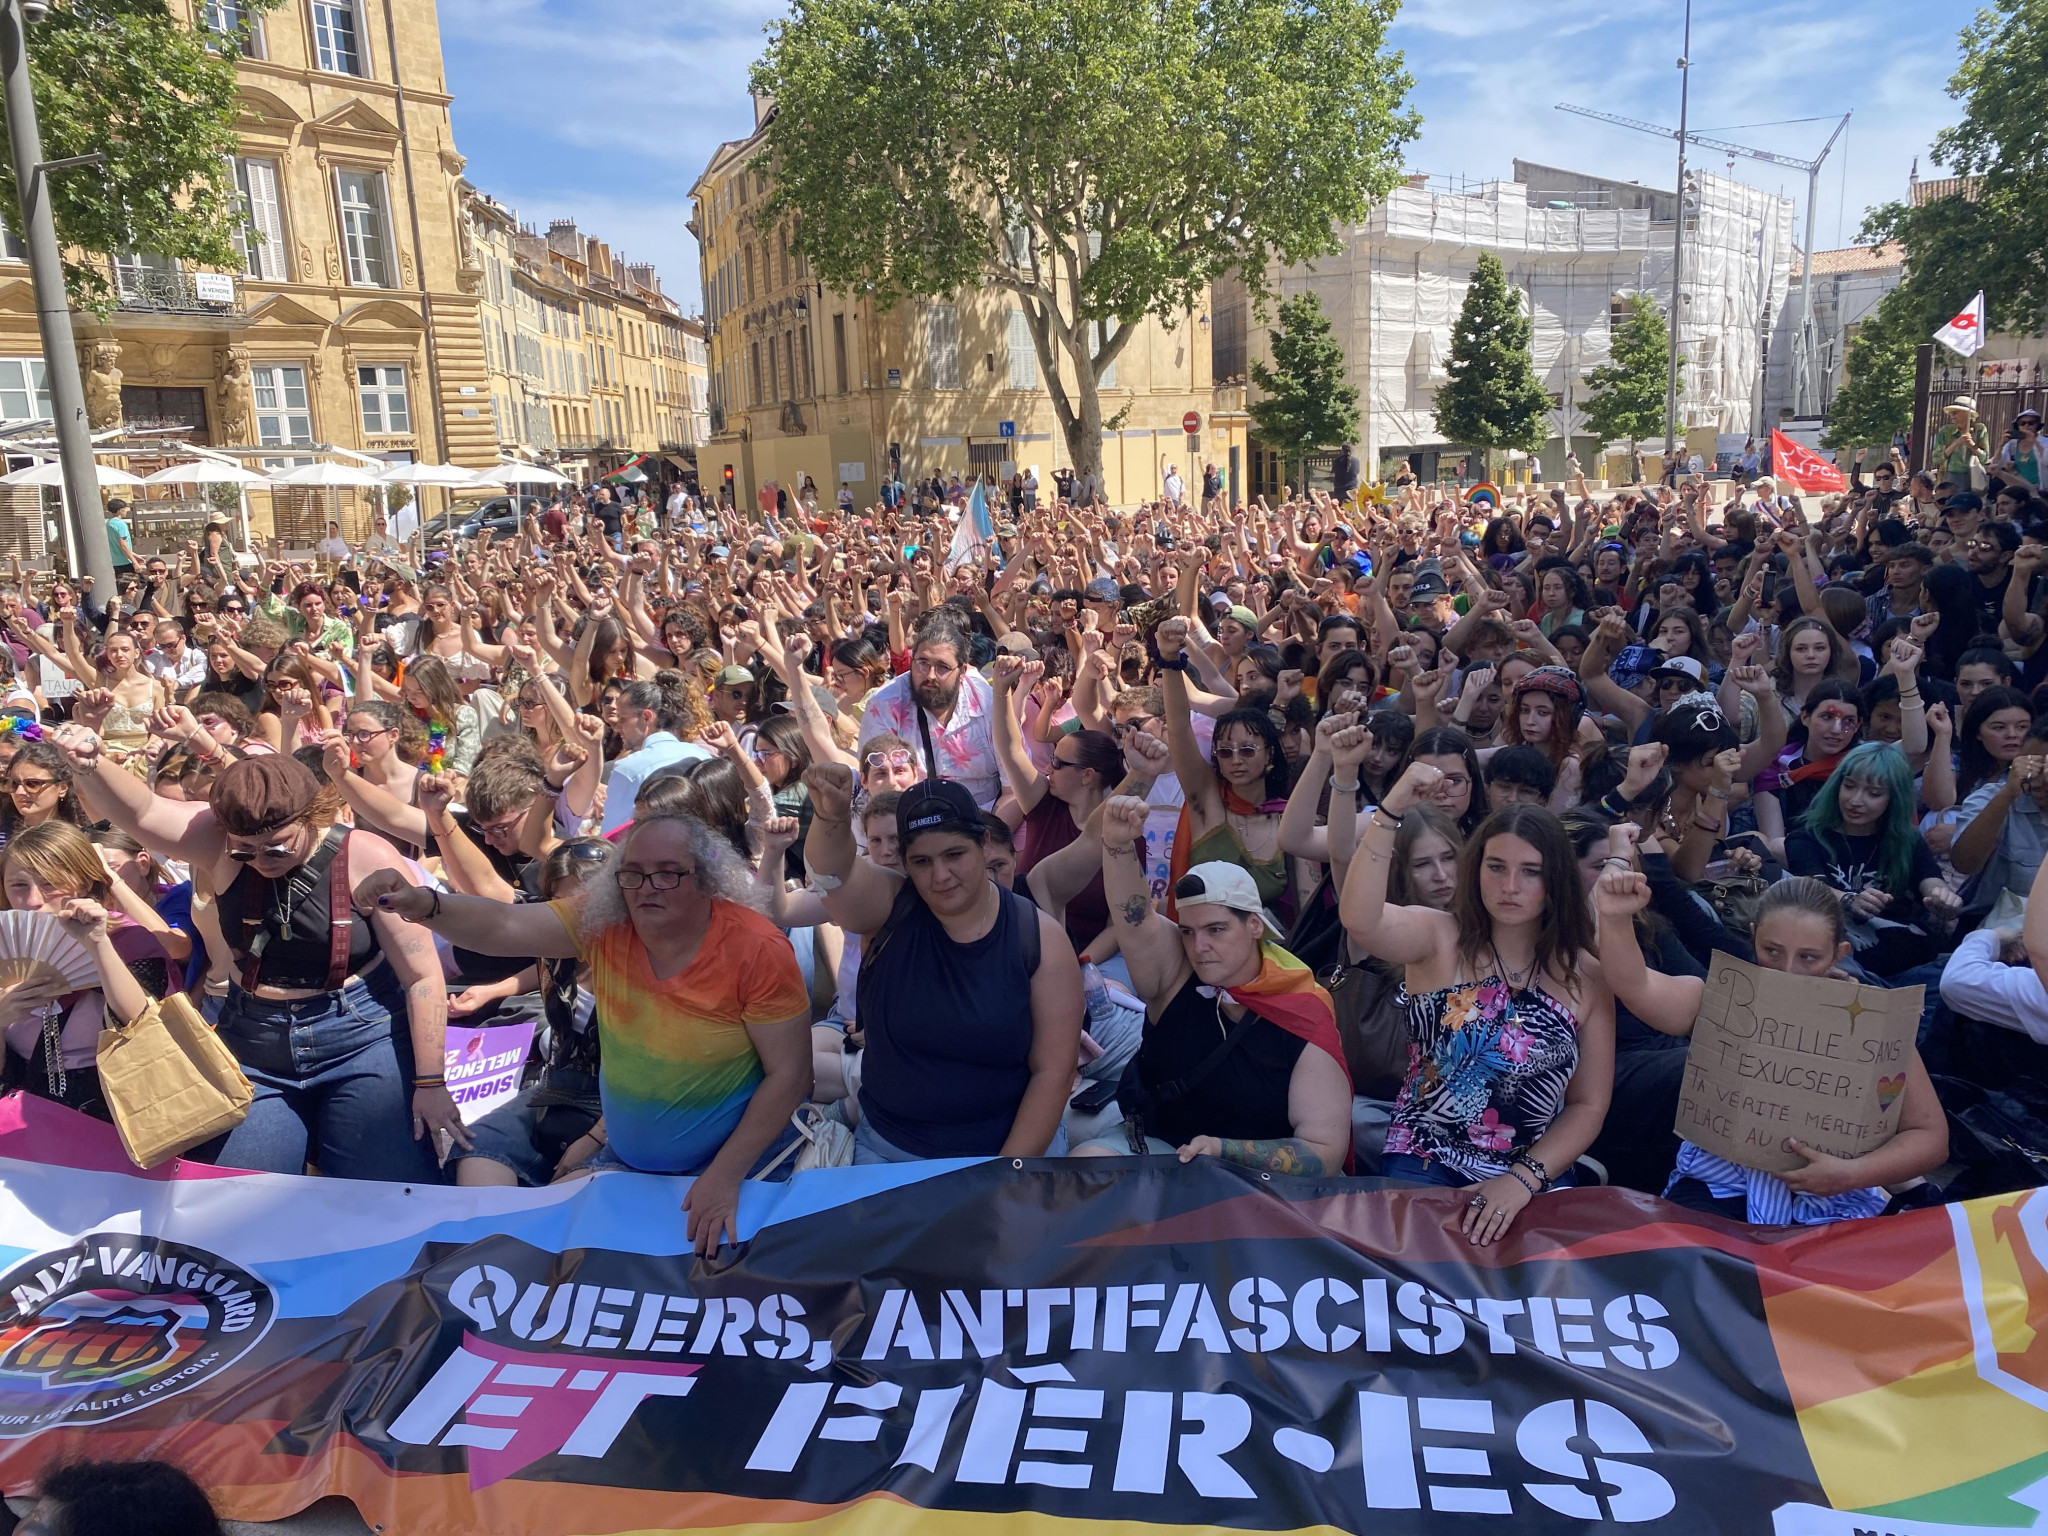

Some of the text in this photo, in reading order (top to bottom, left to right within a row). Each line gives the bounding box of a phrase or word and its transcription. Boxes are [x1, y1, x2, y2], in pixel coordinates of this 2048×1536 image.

[908, 815, 942, 829] LOS ANGELES
[1705, 967, 1903, 1065] BRILLE SANS
[1680, 1098, 1733, 1139] PLACE
[1745, 1127, 1772, 1148] AU
[1874, 1119, 1889, 1135] SA
[10, 1246, 257, 1334] AIX-VANGUARD
[447, 1264, 1681, 1372] QUEERS, ANTIFASCISTES
[138, 1351, 221, 1397] LGBTQIA+
[387, 1345, 698, 1459] ET
